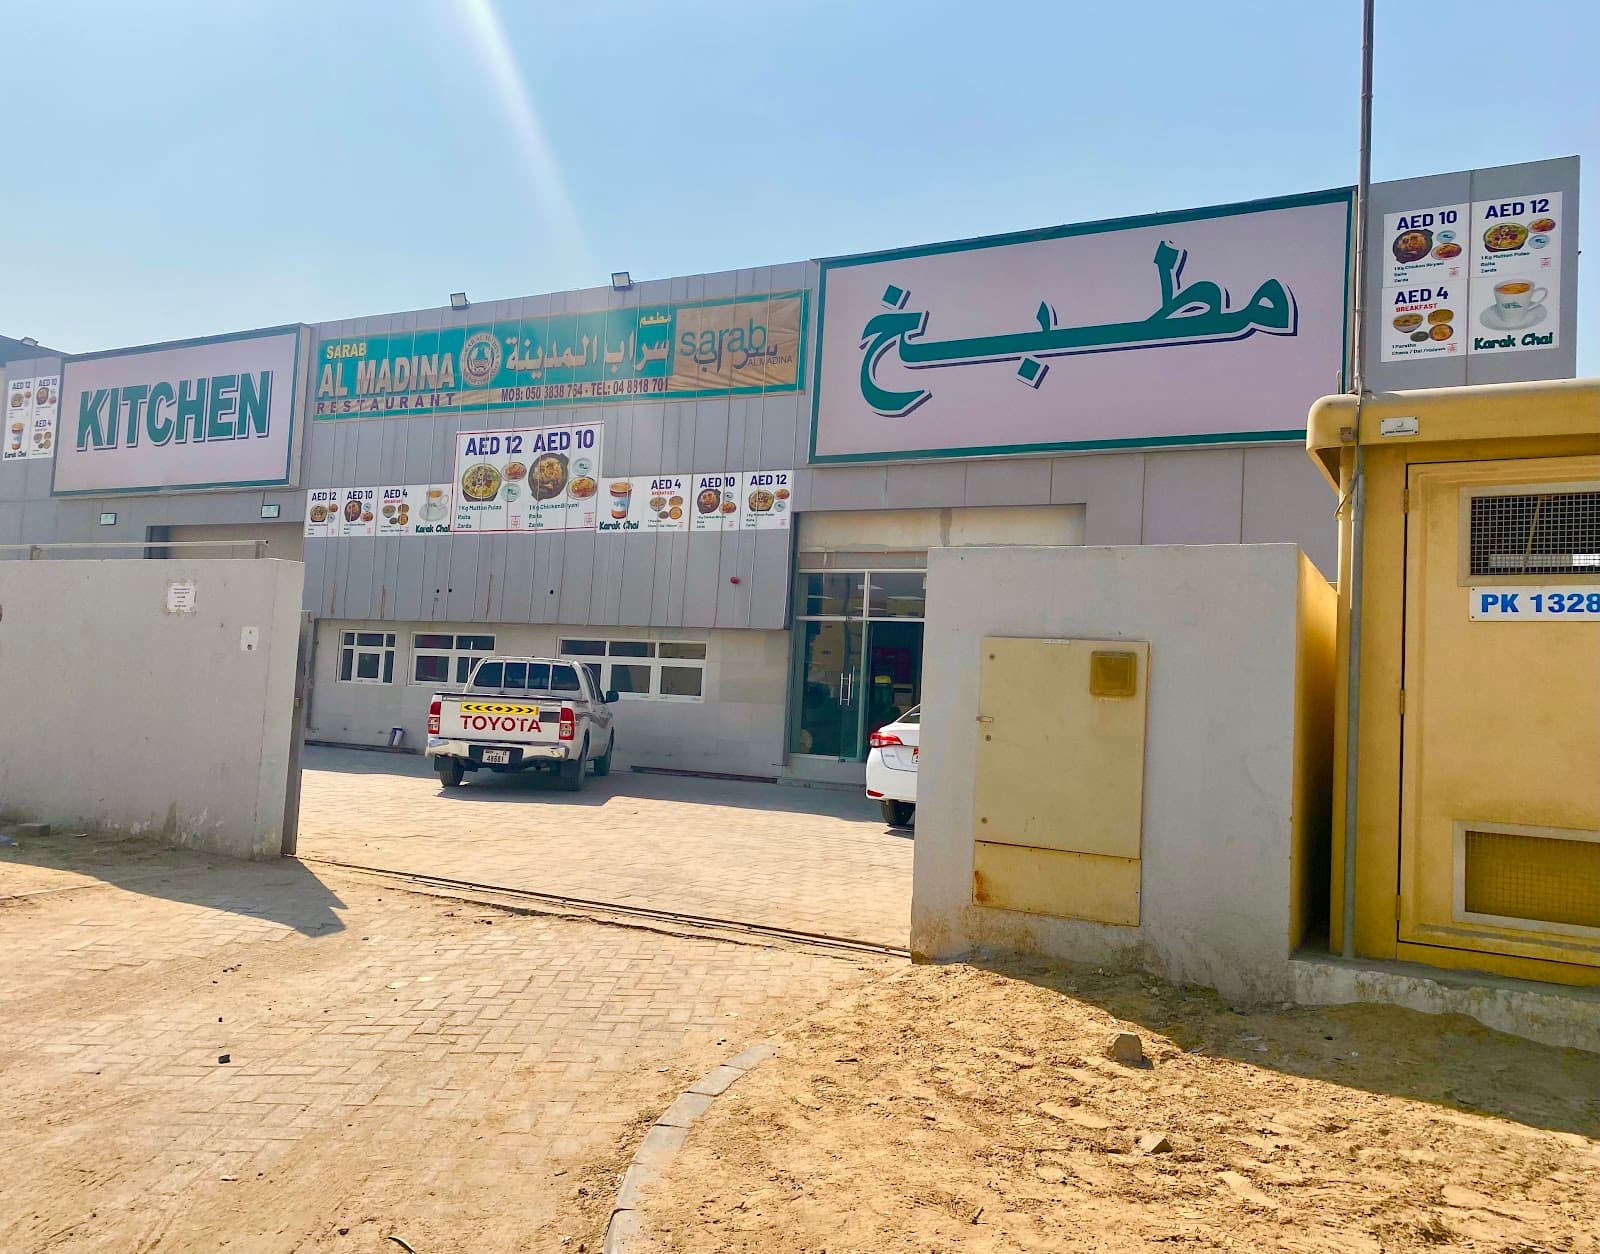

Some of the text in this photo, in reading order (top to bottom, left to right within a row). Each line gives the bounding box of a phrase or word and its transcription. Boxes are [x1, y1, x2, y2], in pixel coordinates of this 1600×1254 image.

[1485, 199, 1549, 219] AED 12
[1396, 210, 1457, 230] AED 10
[1394, 287, 1449, 304] AED 4
[1395, 303, 1437, 312] BREAKFAST
[680, 318, 767, 357] sarab
[859, 240, 1297, 417] مطبخ
[326, 343, 367, 359] SARAB
[1474, 332, 1553, 350] Karak Chai
[505, 334, 599, 380] المدينة
[604, 330, 670, 374] سراب
[318, 362, 348, 398] AL
[356, 353, 456, 395] MADINA
[501, 388, 523, 401] MOB:
[525, 386, 541, 399] 050
[590, 381, 611, 396] TEL:
[613, 381, 624, 394] 04
[76, 370, 273, 452] KITCHEN
[317, 393, 456, 414] RESTAURANT
[465, 435, 523, 456] AED 12
[533, 429, 595, 453] AED 10
[651, 479, 681, 490] AED 4
[700, 477, 735, 488] AED 10
[750, 474, 787, 486] AED 12
[312, 492, 337, 501] AED 12
[347, 490, 373, 500] AED 10
[384, 489, 408, 499] AED 4
[599, 520, 639, 530] Karak Chai
[1481, 593, 1600, 613] PK 1328
[460, 715, 542, 733] TOYOTA
